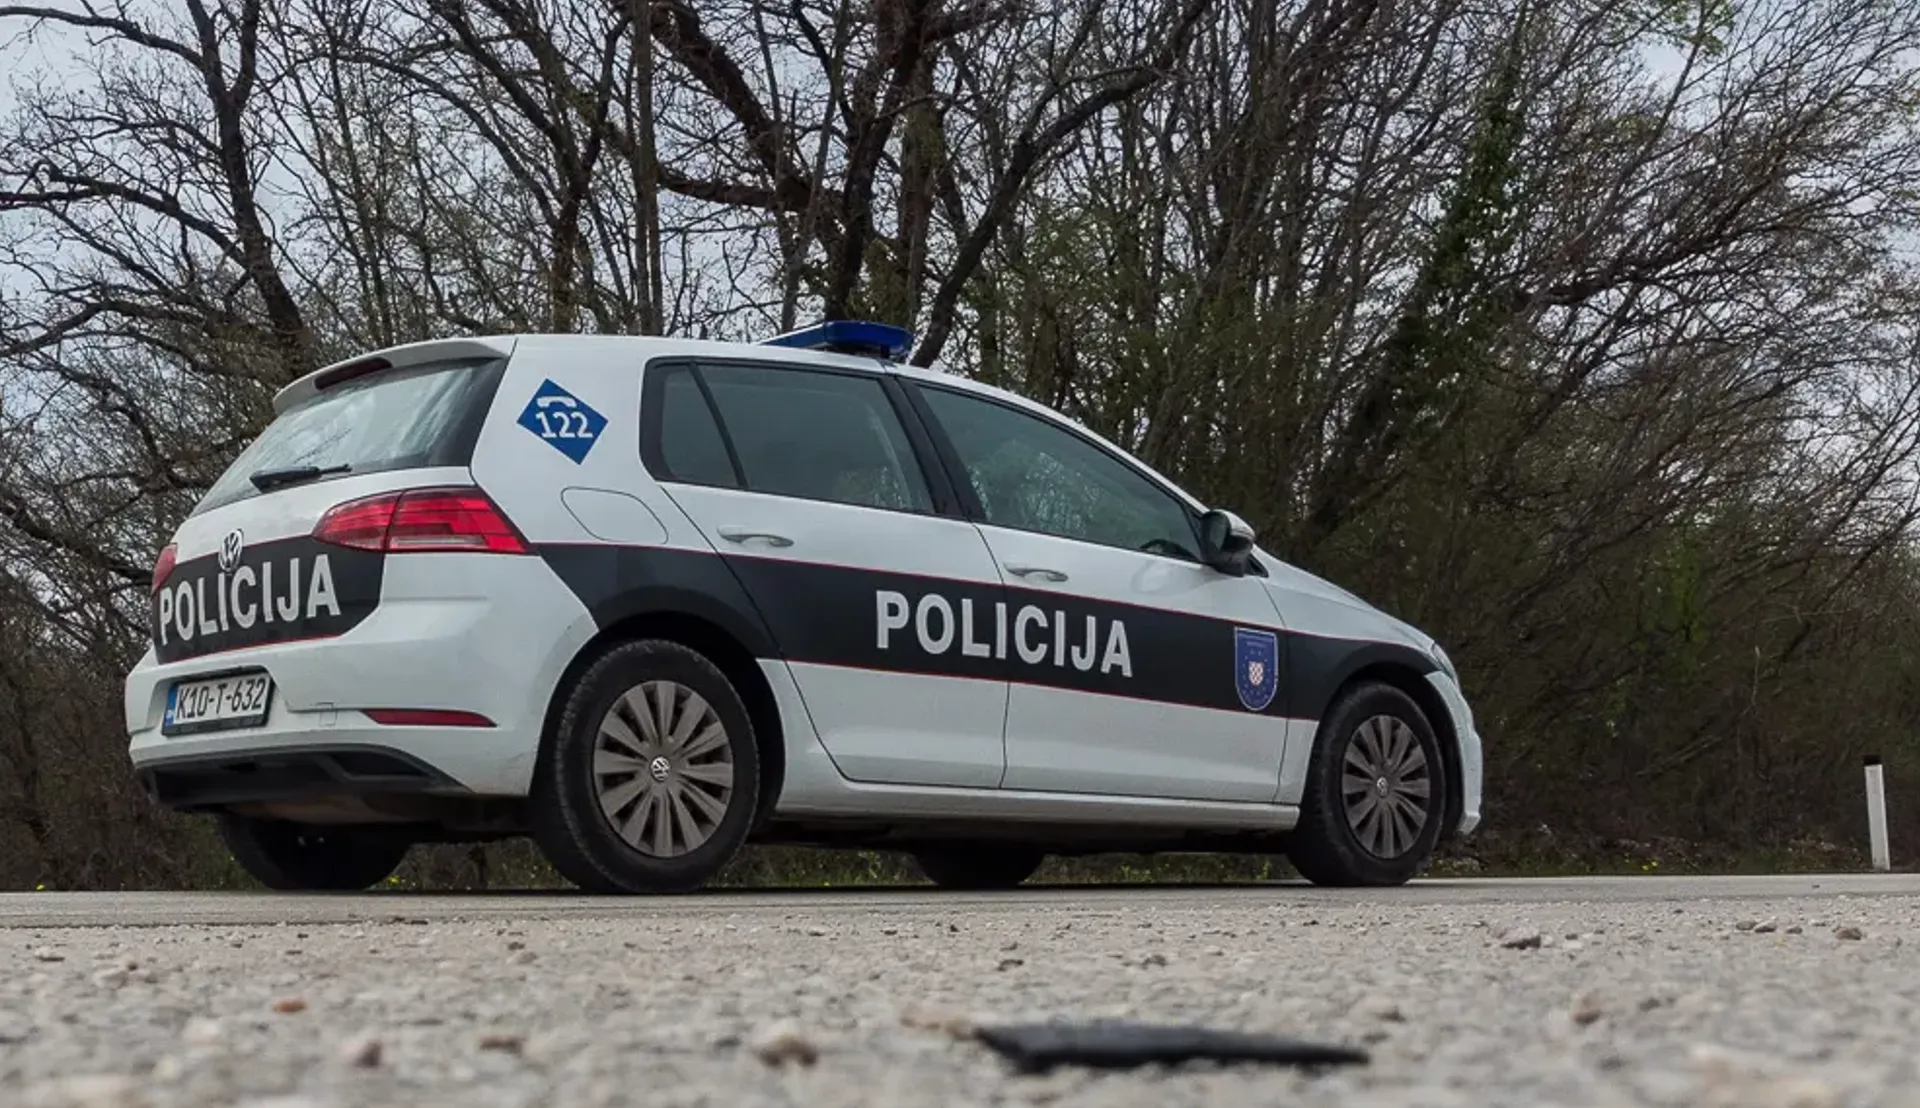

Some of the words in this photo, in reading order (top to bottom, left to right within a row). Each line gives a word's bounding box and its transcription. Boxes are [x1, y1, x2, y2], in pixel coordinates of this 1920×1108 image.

[535, 411, 594, 438] 122
[159, 554, 342, 646] POLICIJA
[876, 590, 1133, 678] POLICIJA
